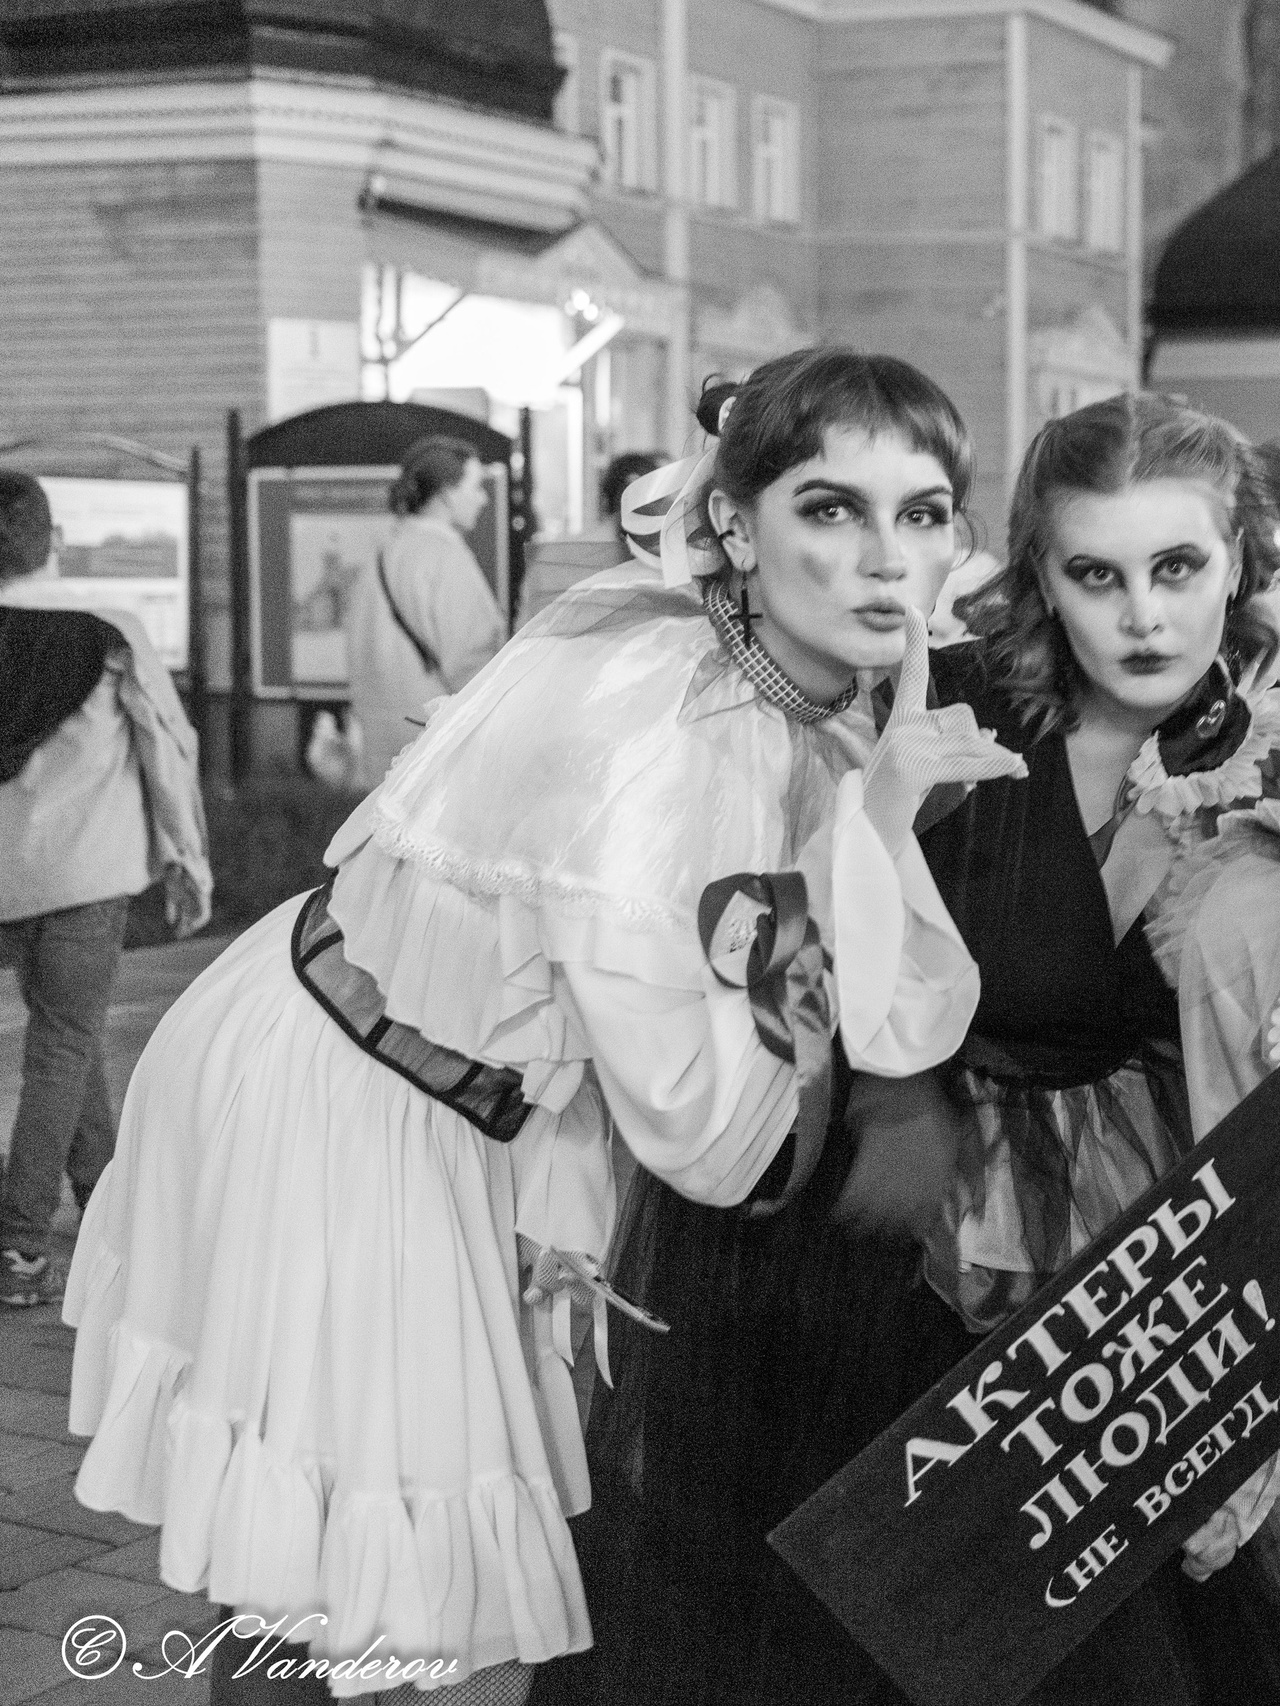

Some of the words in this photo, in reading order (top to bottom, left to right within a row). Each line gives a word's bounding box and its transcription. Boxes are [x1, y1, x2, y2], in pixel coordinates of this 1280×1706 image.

[904, 1158, 1236, 1508] АКТЕРЫ
[1000, 1256, 1228, 1465] ТОЖЕ
[1020, 1279, 1276, 1550] ЛЮДИ!
[1044, 1524, 1130, 1608] (НЕ
